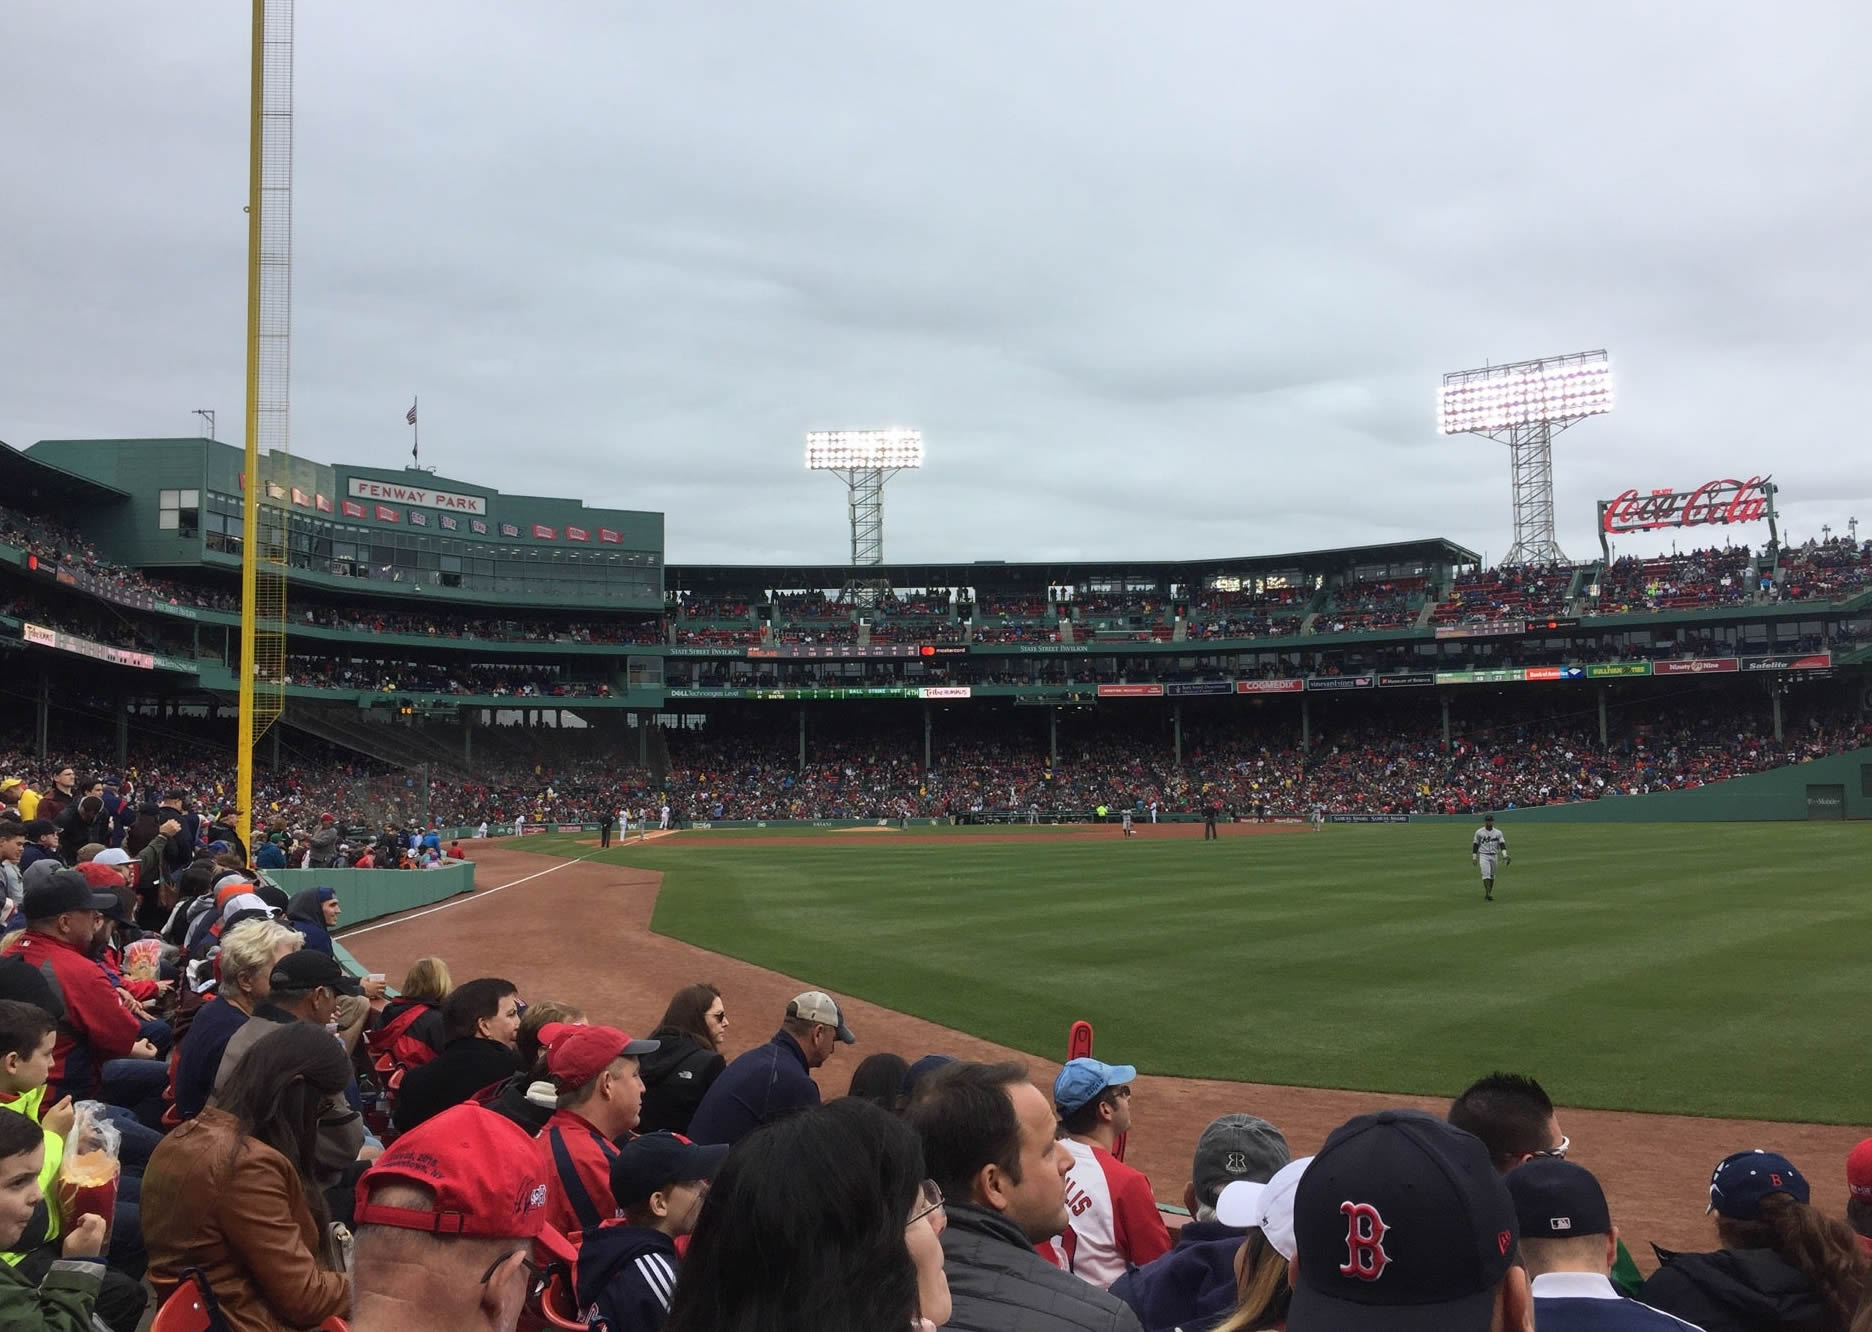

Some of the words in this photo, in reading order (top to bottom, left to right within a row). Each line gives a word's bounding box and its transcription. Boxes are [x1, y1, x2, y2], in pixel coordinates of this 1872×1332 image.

[358, 483, 425, 503] FENWAY
[436, 494, 477, 510] PARK
[1603, 474, 1772, 534] Coca-Cola
[1246, 680, 1295, 690] COGMEDIX
[1768, 1172, 1784, 1188] B
[1339, 1200, 1393, 1282] B
